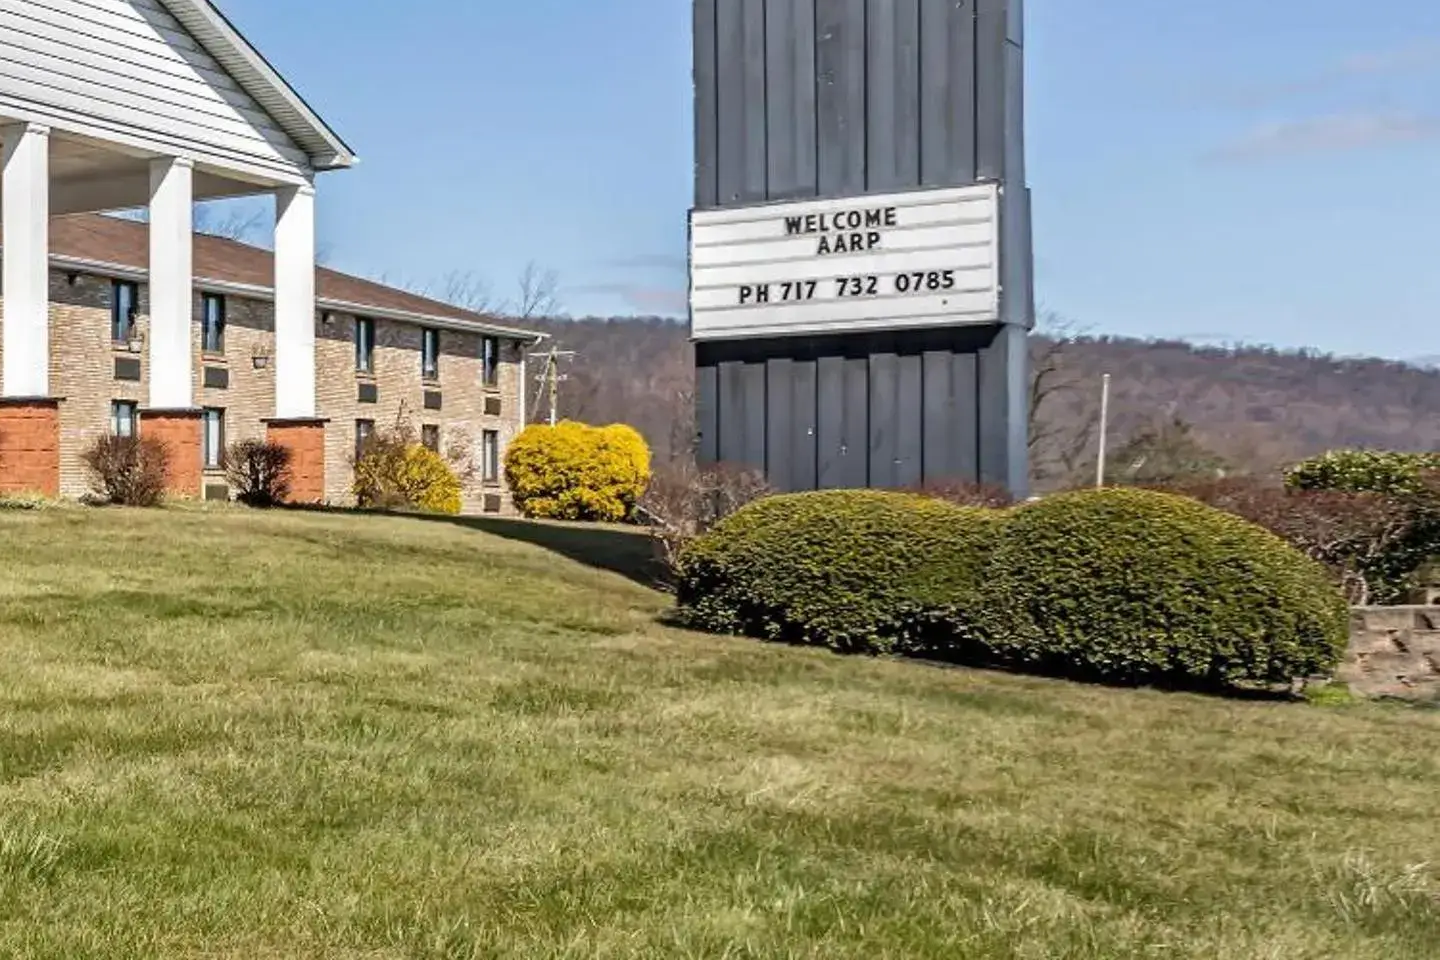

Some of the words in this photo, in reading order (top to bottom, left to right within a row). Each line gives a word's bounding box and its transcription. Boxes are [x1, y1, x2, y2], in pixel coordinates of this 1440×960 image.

[784, 206, 897, 235] WELCOME
[817, 231, 882, 256] AARP
[738, 283, 769, 305] PH
[780, 280, 817, 301] 717
[835, 275, 878, 297] 732
[894, 269, 955, 293] 0785
